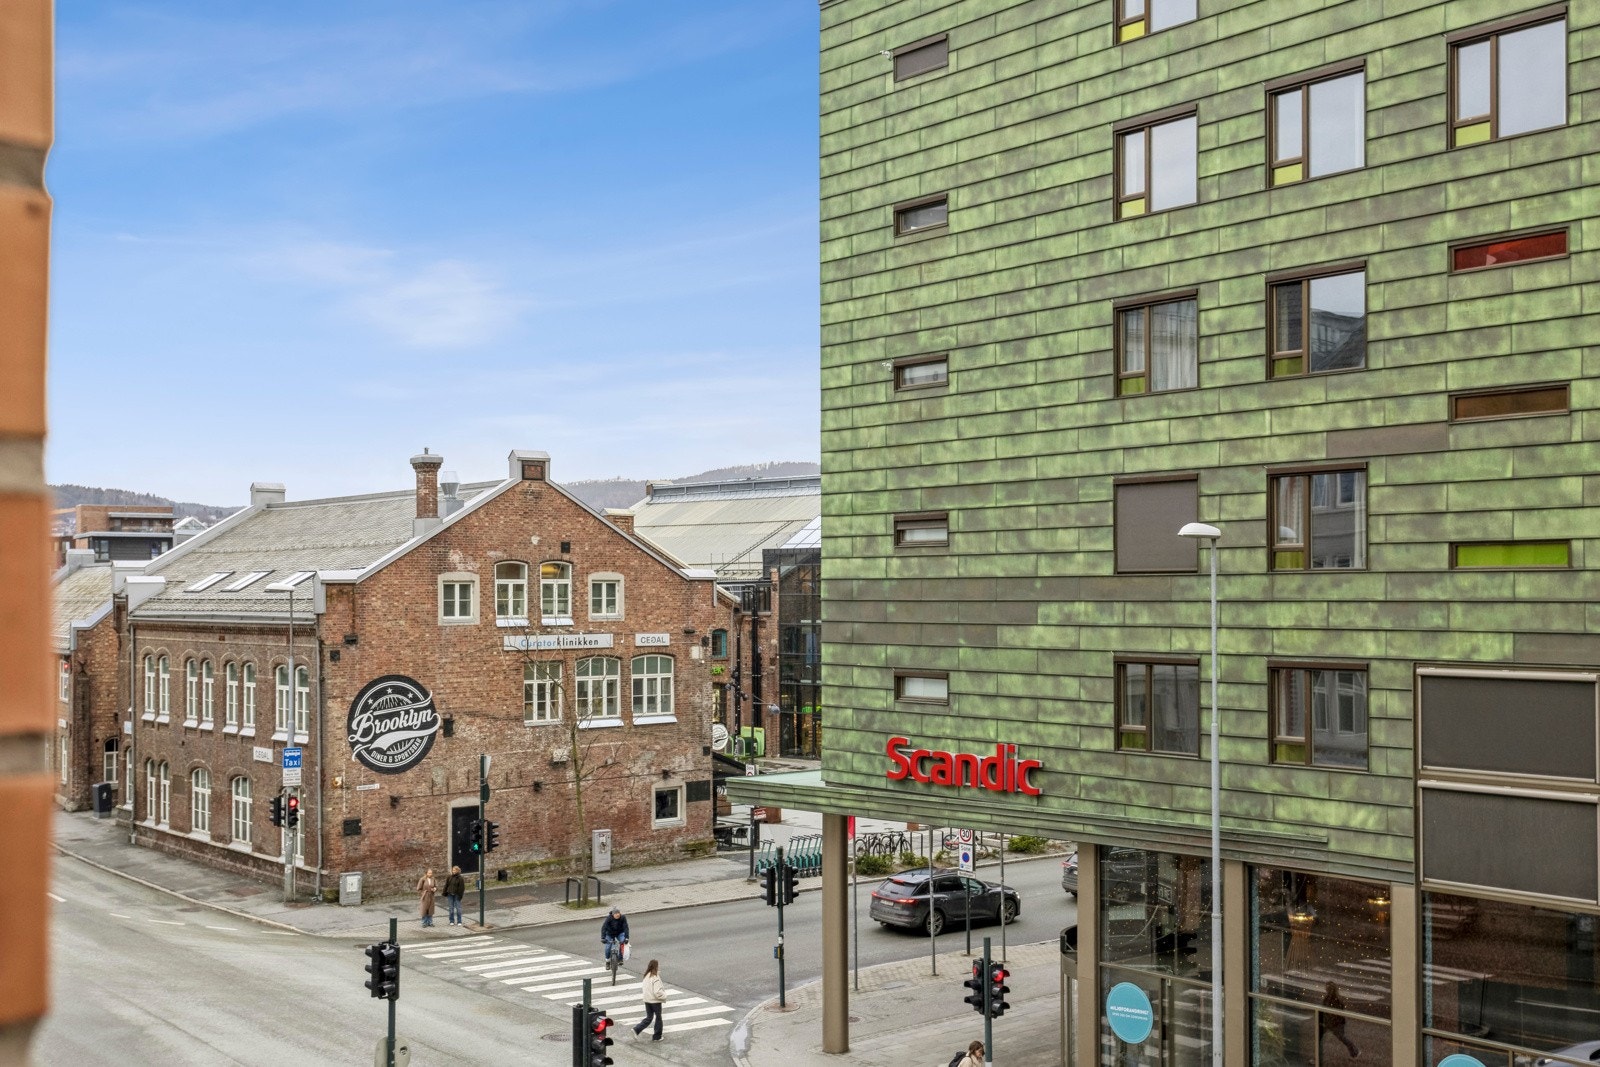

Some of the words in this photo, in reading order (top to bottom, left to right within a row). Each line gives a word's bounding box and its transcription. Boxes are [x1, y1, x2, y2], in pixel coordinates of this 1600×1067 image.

[348, 709, 433, 743] Brooklyn
[285, 758, 301, 767] Taxi
[370, 750, 387, 763] DINER
[394, 738, 422, 763] SPORTSBAR
[886, 736, 1043, 796] Scandic
[962, 829, 970, 838] 30
